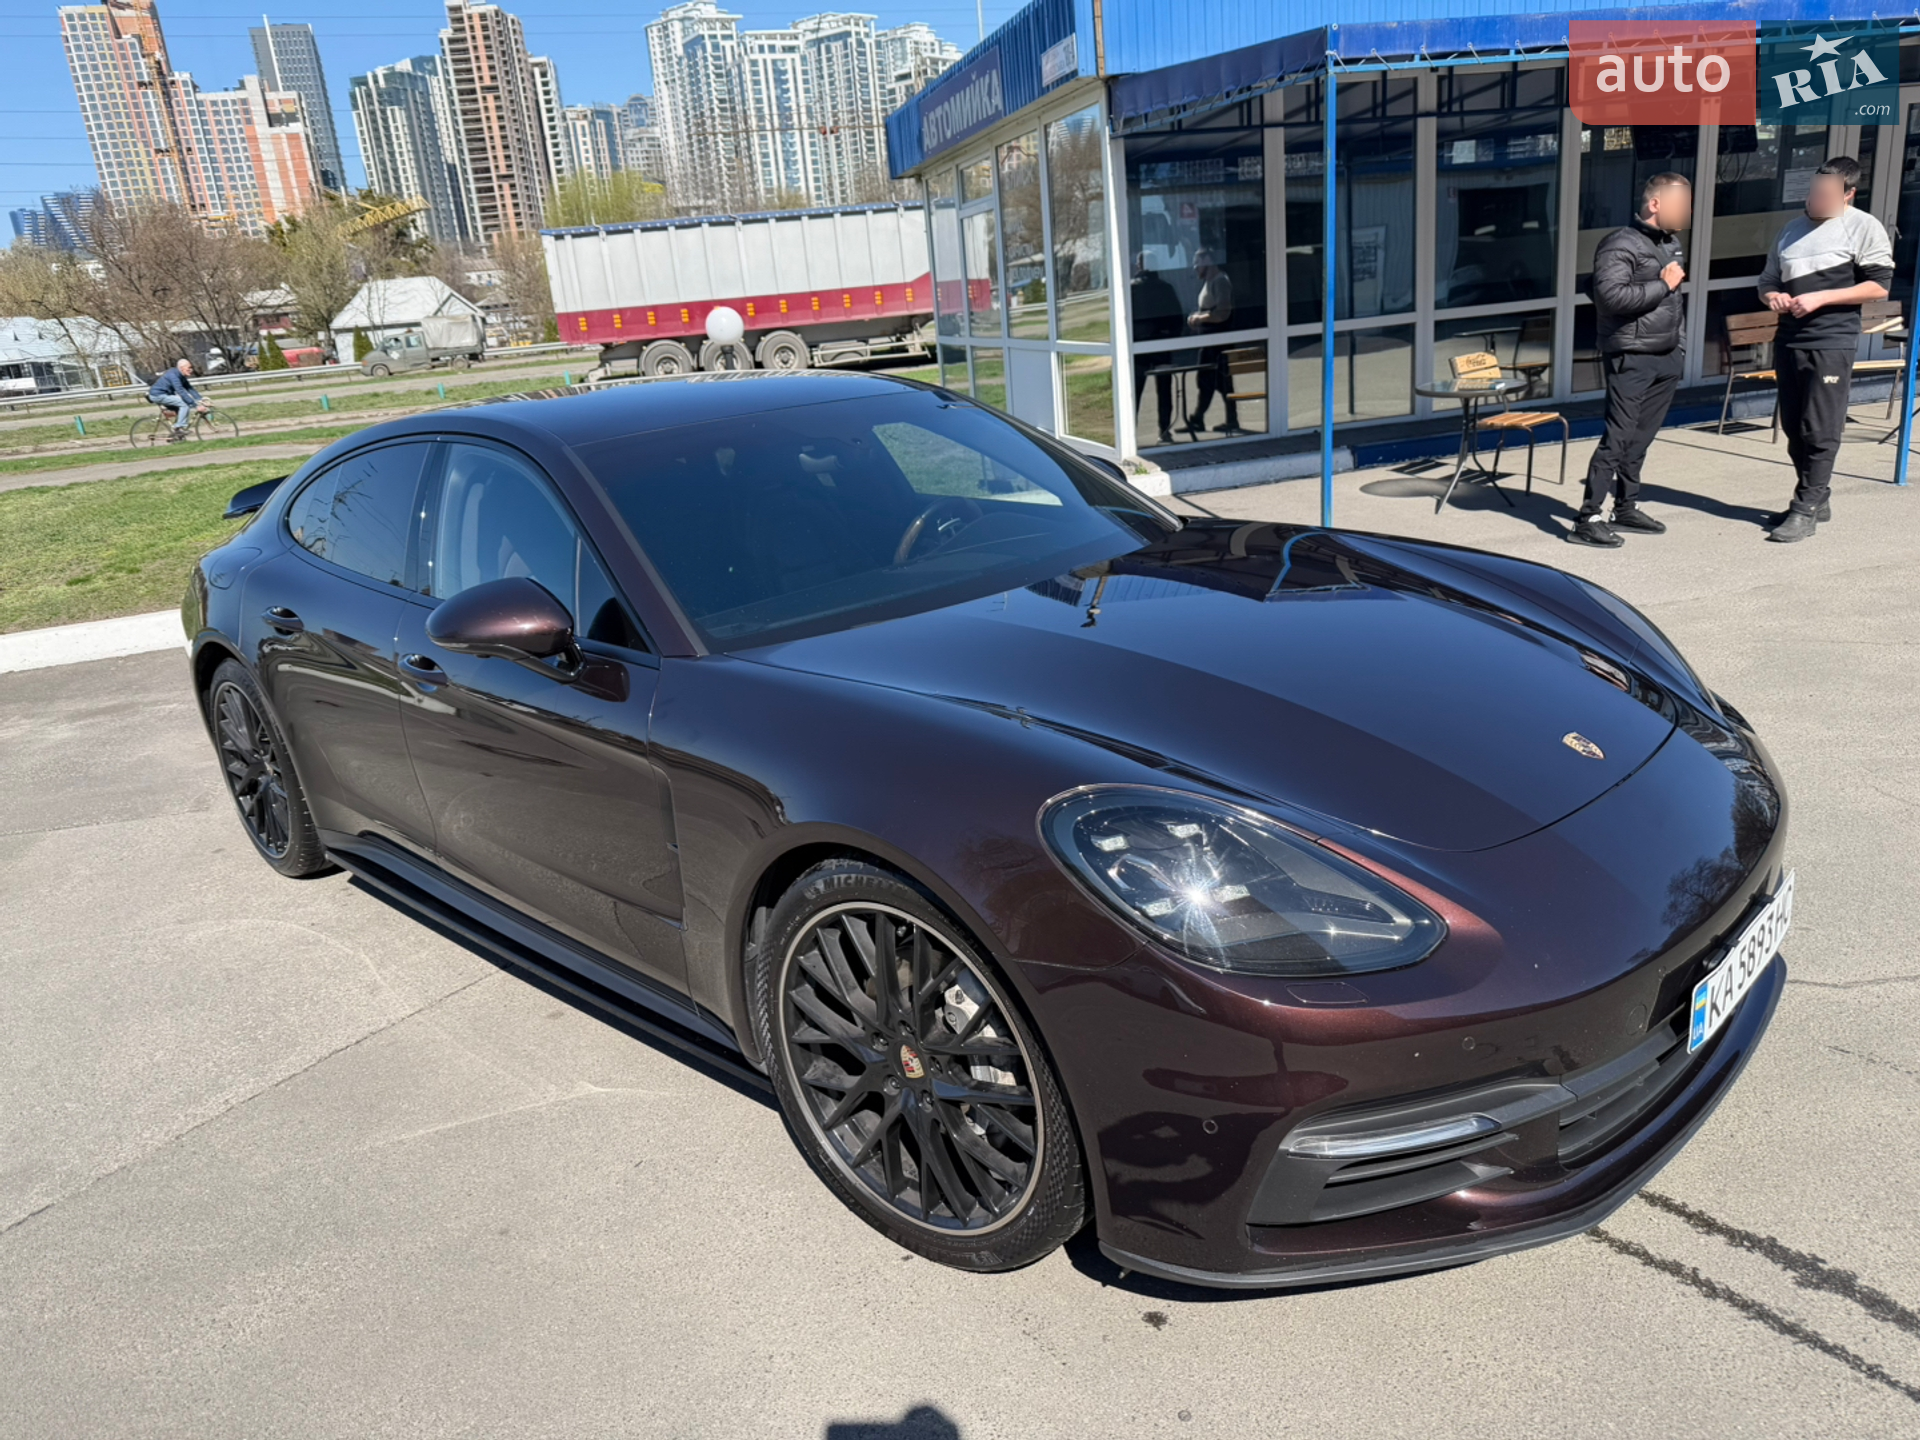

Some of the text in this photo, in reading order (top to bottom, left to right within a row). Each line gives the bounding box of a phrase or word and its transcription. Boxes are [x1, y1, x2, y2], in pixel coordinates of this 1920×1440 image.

[923, 69, 1003, 152] АВТОМИЙКА
[1709, 963, 1734, 1029] KA
[1737, 911, 1774, 991] 5893
[1693, 1022, 1704, 1040] UA
